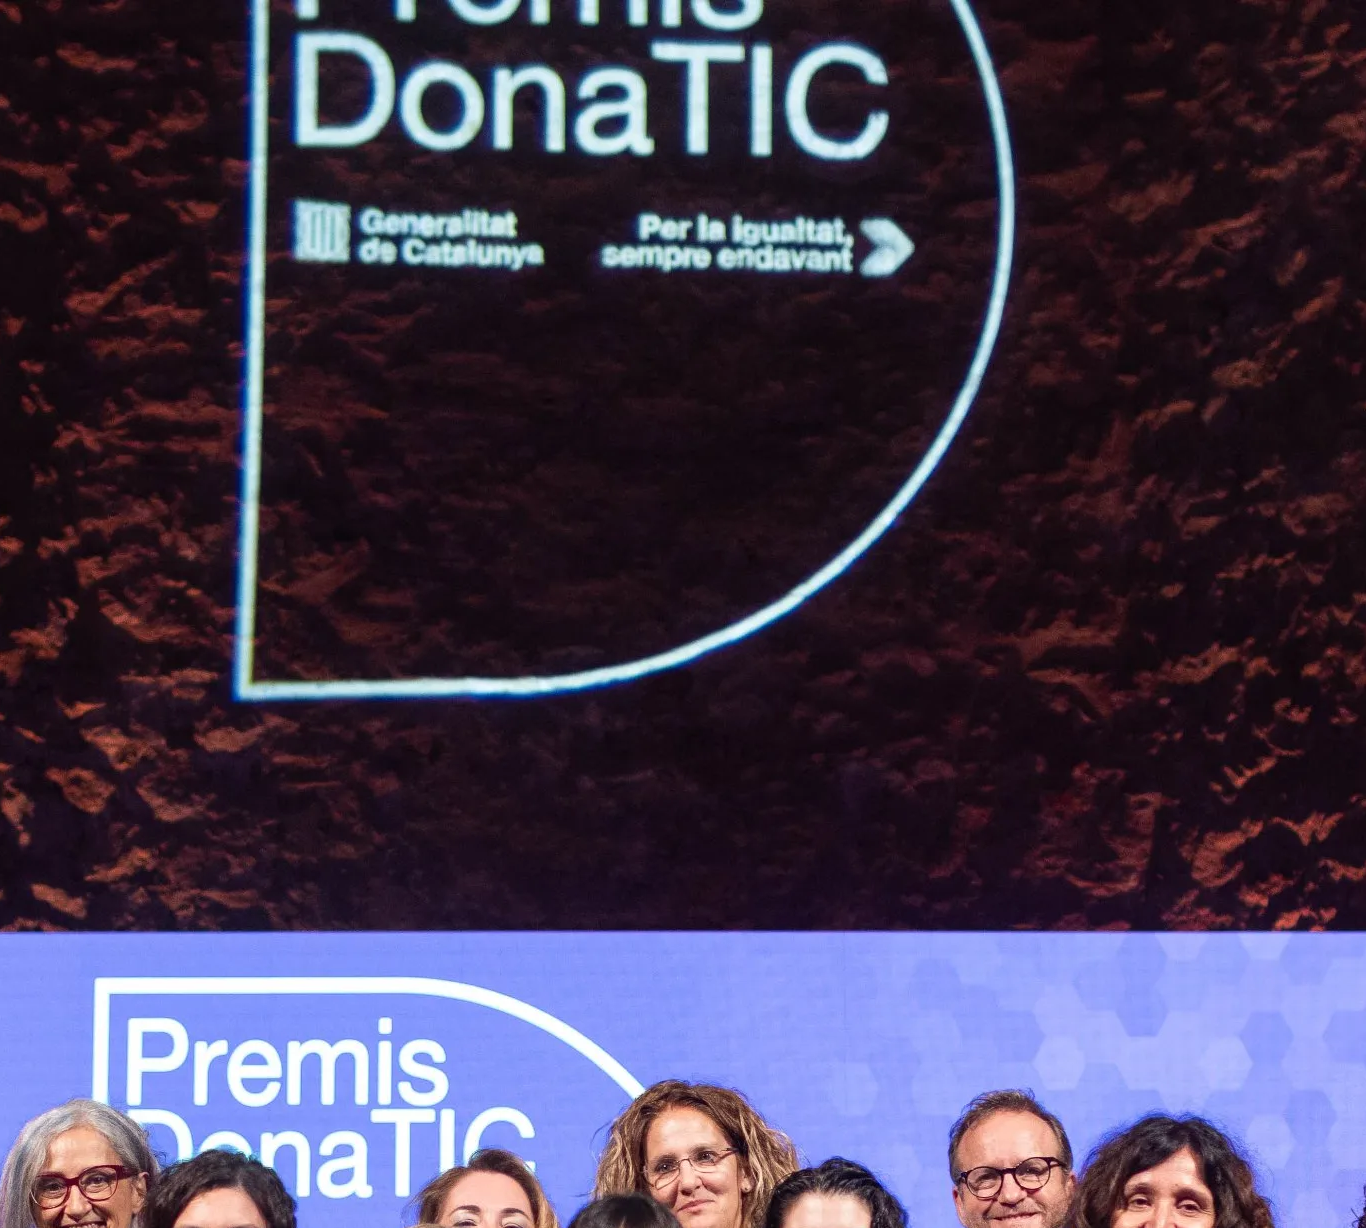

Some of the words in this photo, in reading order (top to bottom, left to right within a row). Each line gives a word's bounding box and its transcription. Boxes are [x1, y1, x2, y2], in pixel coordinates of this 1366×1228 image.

[295, 30, 890, 161] DonaTIC
[359, 207, 518, 238] Generalitat
[638, 213, 693, 241] Per
[697, 213, 727, 242] la
[731, 214, 854, 248] igualtat,
[359, 237, 398, 264] de
[401, 238, 545, 271] Catalunya
[601, 244, 713, 272] sempre
[716, 244, 854, 272] endavant
[126, 1016, 449, 1108] Premis
